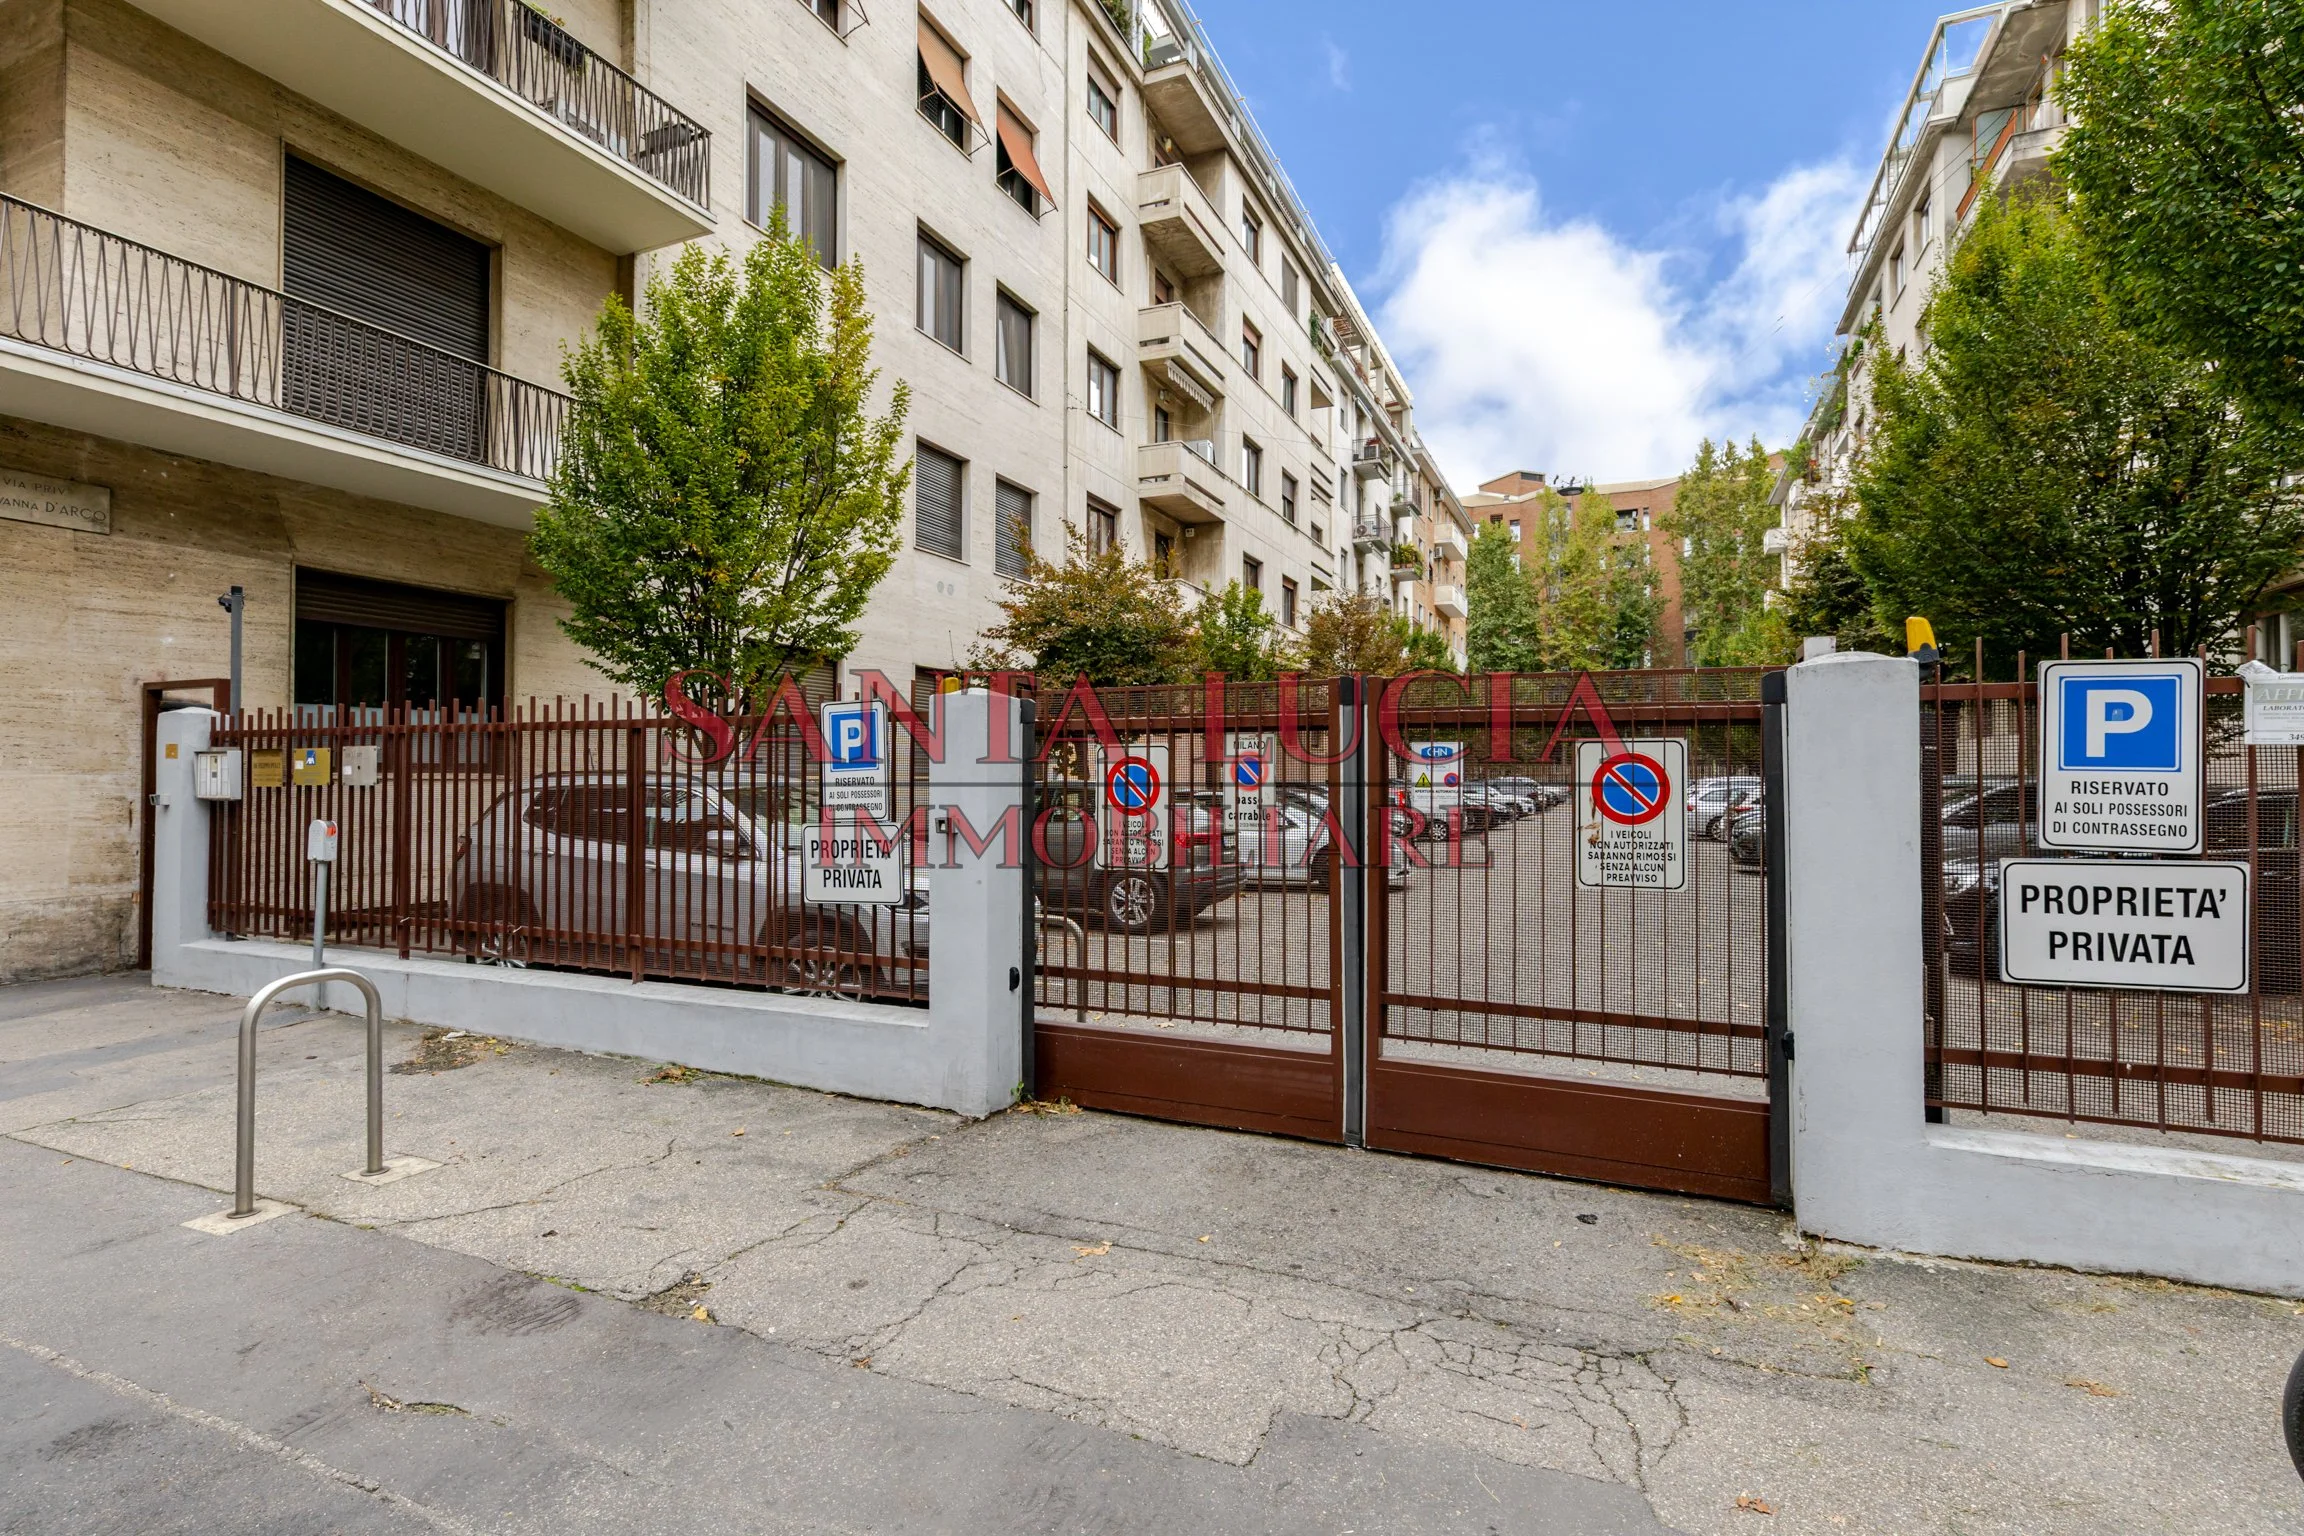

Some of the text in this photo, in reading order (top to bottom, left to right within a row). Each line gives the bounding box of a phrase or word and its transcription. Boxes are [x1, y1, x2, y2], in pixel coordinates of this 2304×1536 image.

[3, 478, 66, 495] VIA PRIV
[45, 501, 107, 522] D'ARCO
[2086, 689, 2153, 758] P
[840, 719, 868, 763] P
[1233, 741, 1266, 750] ILANO
[835, 777, 875, 787] RISERVATO
[2071, 781, 2169, 797] RISERVATO
[829, 790, 883, 800] AI SOLI POSSESSORI
[837, 803, 883, 812] CONTRASSEGNO
[2054, 803, 2188, 818] AI SOLI POSSESSORI
[1228, 810, 1271, 821] crrable
[1616, 830, 1652, 839] VEICOLI
[2053, 822, 2188, 838] DI CONTRASSEGNO
[1111, 847, 1156, 855] SENA ALCN
[1589, 841, 1674, 850] NON AUTORIZZATI
[1588, 851, 1676, 861] SARANNO RIMOSSI
[1600, 862, 1665, 872] SENZA ALCUN
[823, 869, 882, 889] PRIVATA
[1606, 873, 1658, 883] PREAVVISO
[2020, 884, 2227, 919] PROPRIETA'
[2049, 930, 2196, 966] PRIVATA
